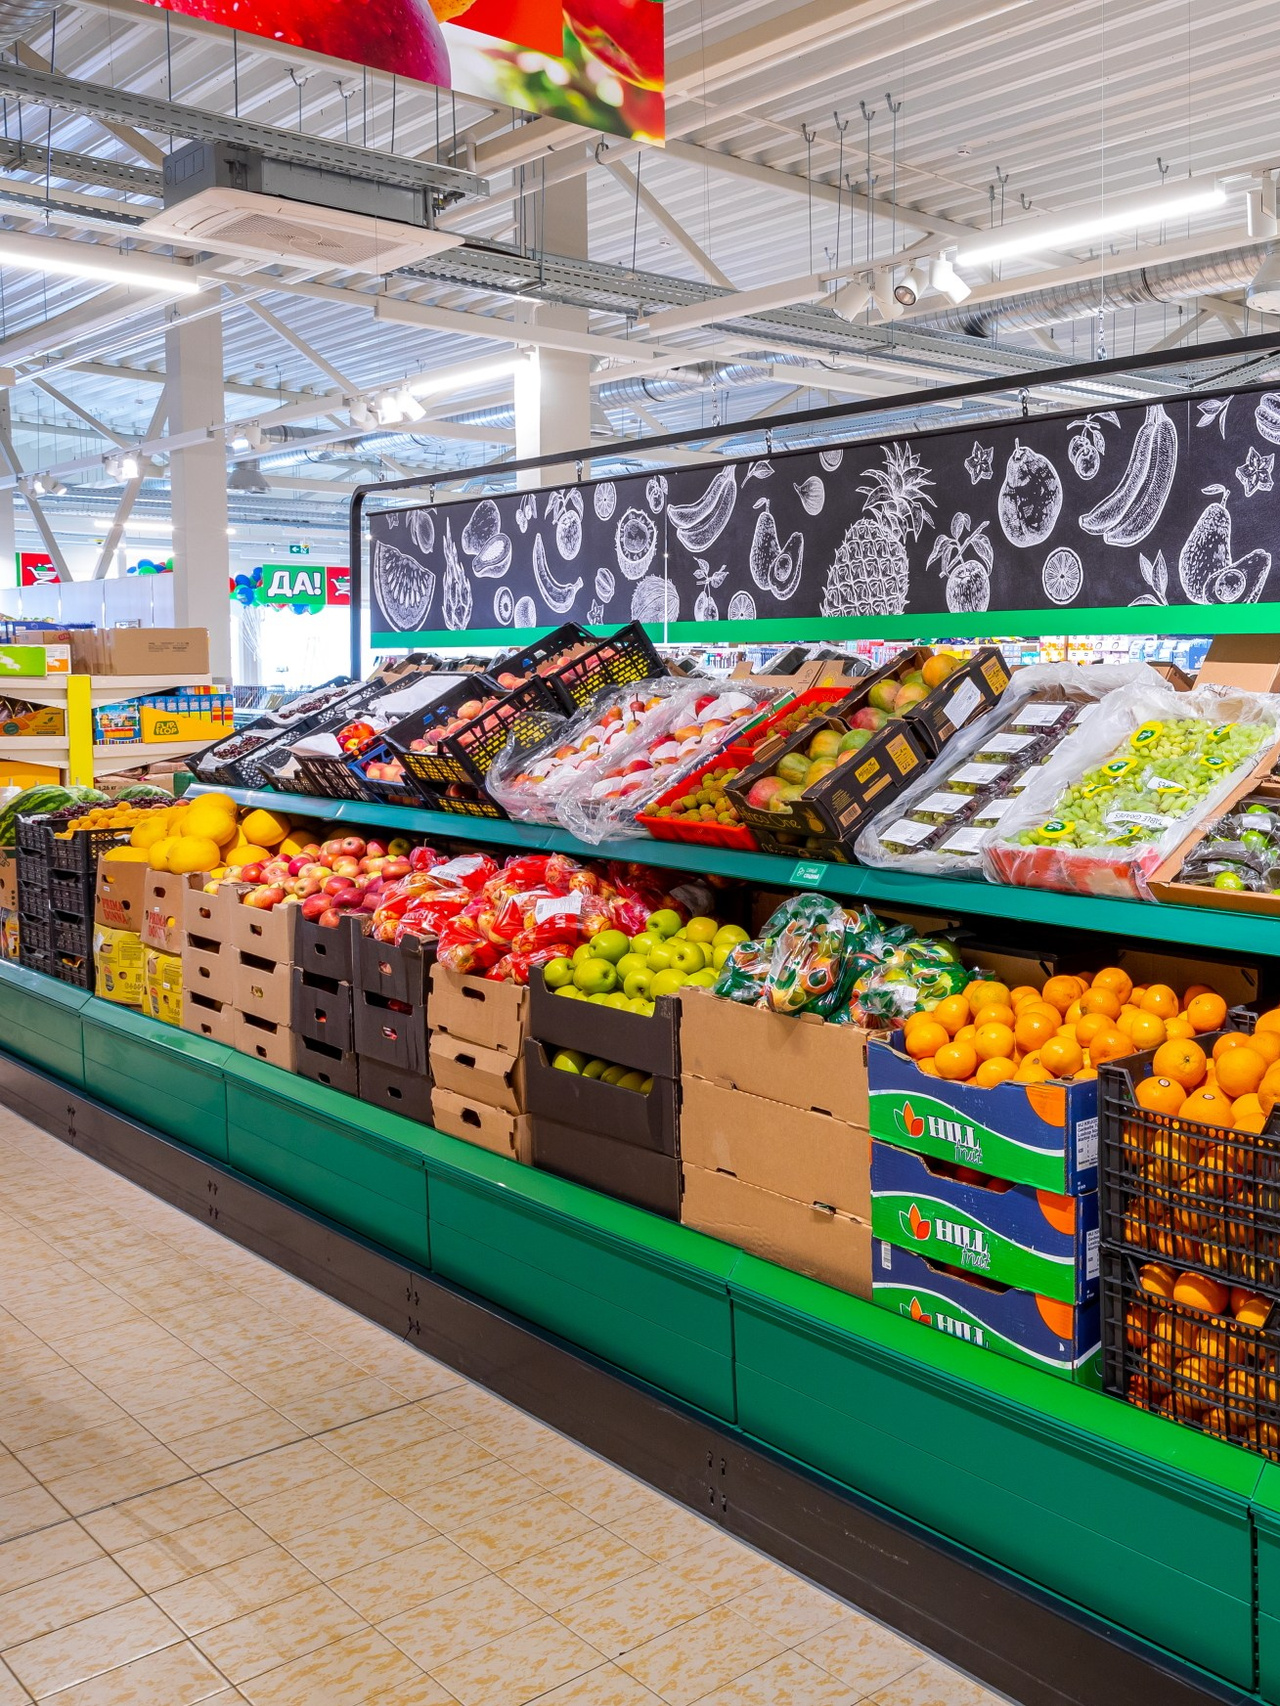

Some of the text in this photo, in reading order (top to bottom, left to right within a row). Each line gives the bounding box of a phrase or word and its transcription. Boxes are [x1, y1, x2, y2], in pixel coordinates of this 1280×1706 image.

[267, 570, 322, 598] ДА!
[926, 1115, 980, 1150] HILL
[934, 1218, 988, 1254] HILL
